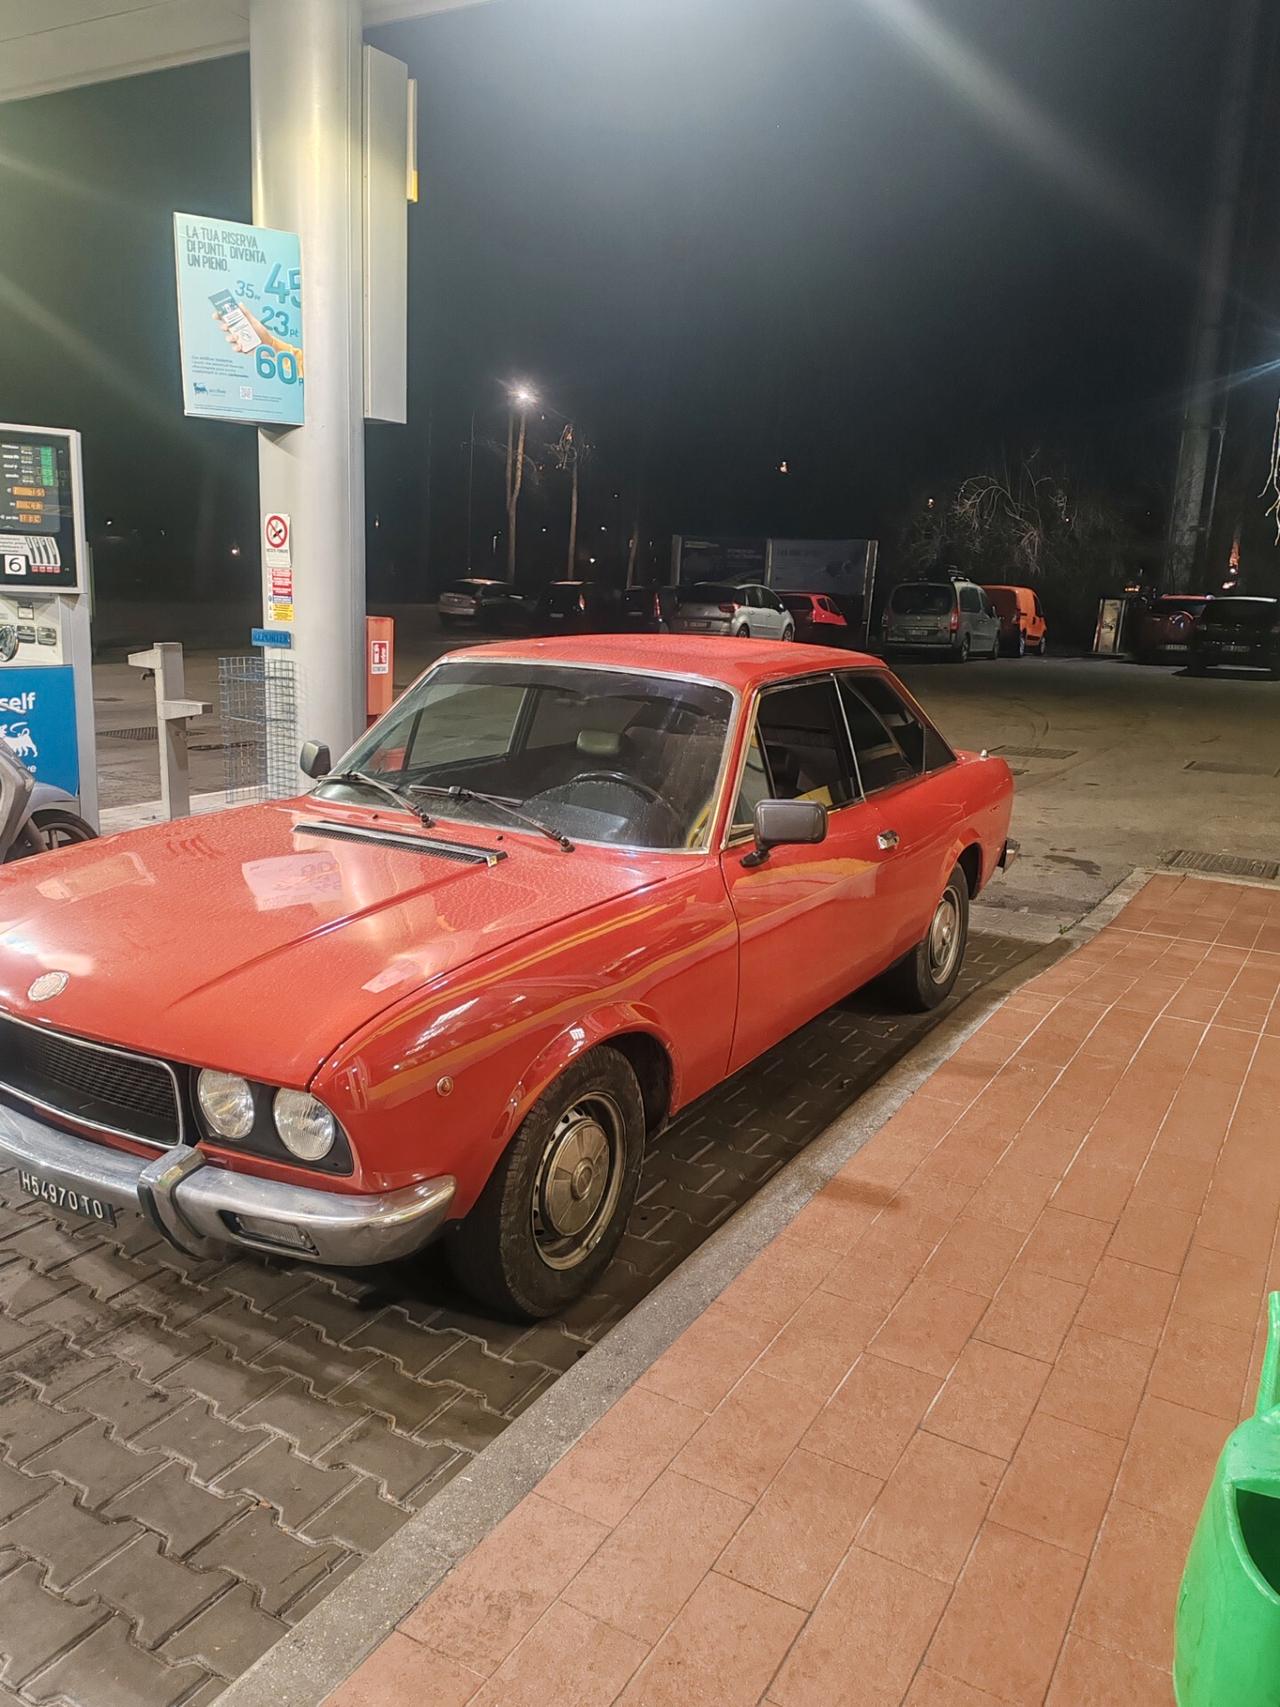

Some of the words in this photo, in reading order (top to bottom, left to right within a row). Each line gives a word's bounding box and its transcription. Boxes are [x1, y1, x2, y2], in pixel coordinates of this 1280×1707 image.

[185, 225, 199, 240] LA
[200, 227, 219, 242] TUA
[221, 230, 258, 249] RISERVA
[187, 239, 196, 252] DI
[198, 240, 228, 258] PUNTI.
[230, 246, 267, 264] DIVENTA
[187, 253, 200, 269] UN
[202, 256, 231, 272] PIENO.
[234, 280, 254, 299] 35
[264, 263, 302, 309] 45
[260, 305, 289, 337] 23
[289, 327, 299, 338] pt
[255, 345, 298, 385] 60
[9, 557, 22, 573] 6
[22, 1171, 78, 1210] H54970
[81, 1195, 104, 1219] TO
